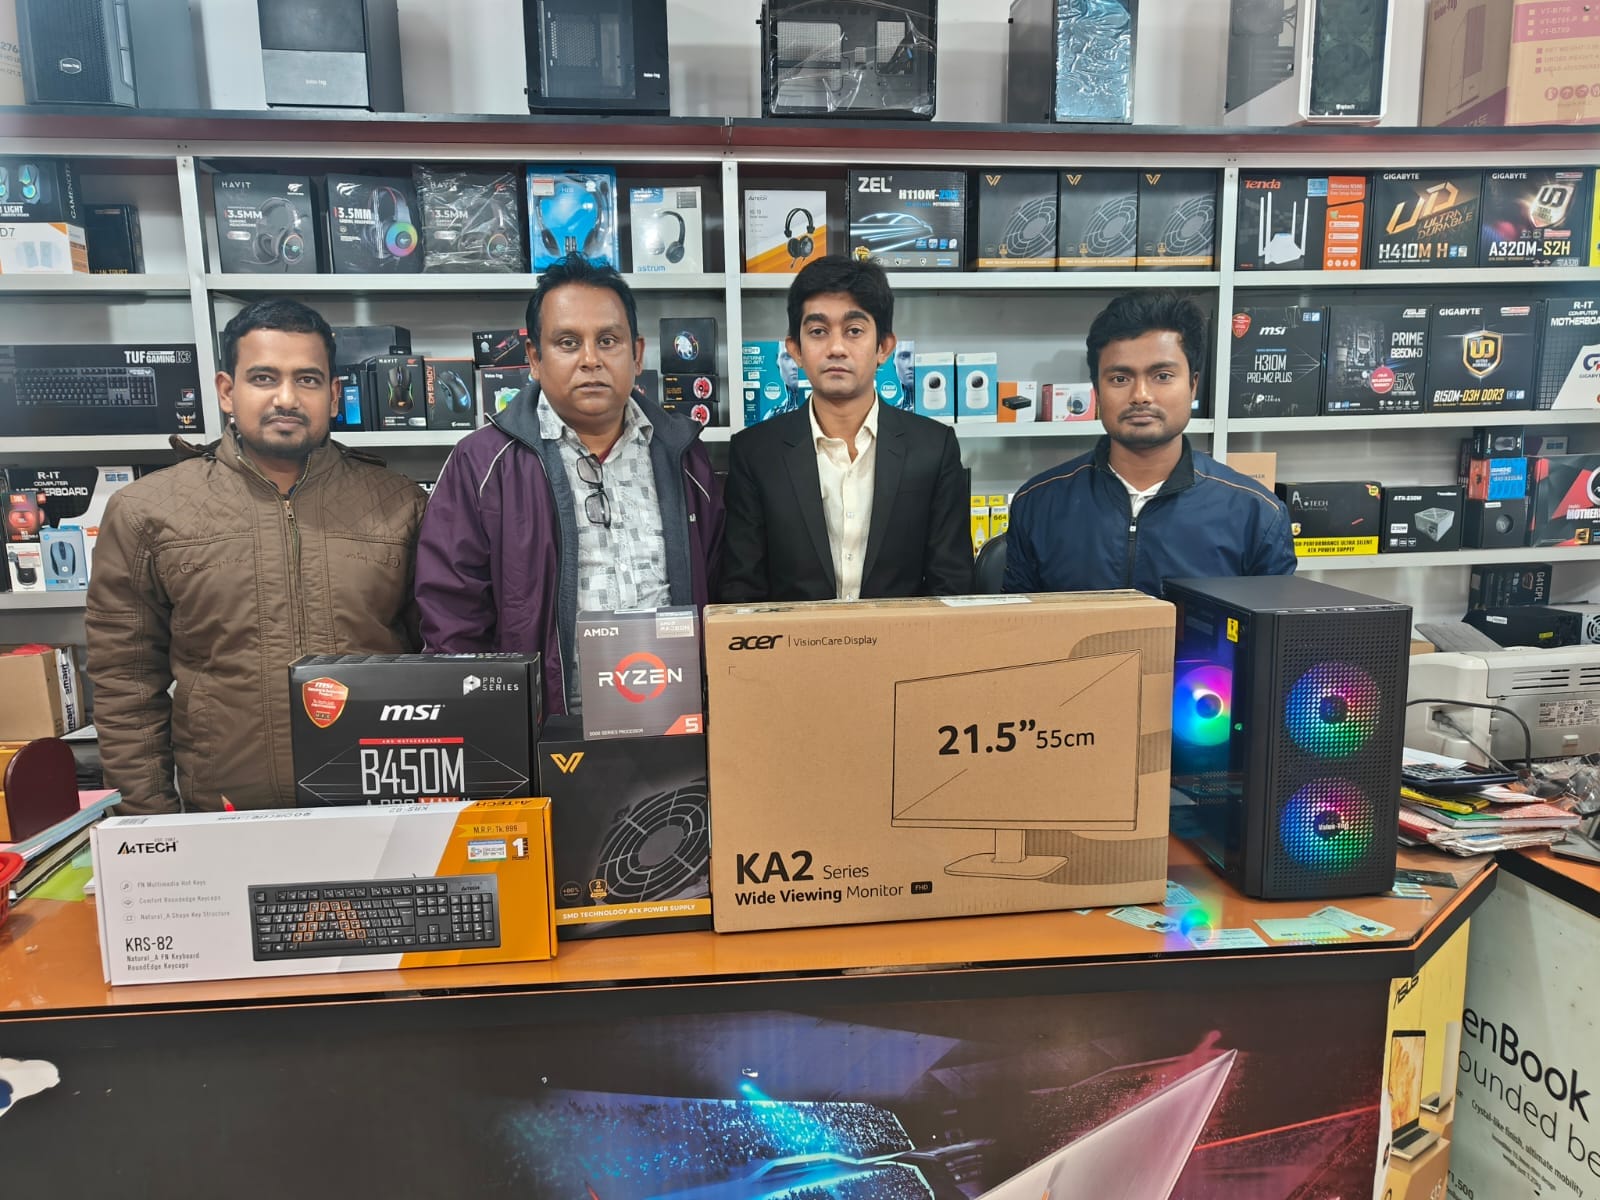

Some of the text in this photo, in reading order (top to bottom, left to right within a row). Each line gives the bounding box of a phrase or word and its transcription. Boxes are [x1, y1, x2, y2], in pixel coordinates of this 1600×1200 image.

[1492, 172, 1527, 180] GIGABYTE
[221, 181, 252, 189] HAVIT
[858, 176, 892, 193] ZEL
[1245, 179, 1282, 189] Tenda
[227, 209, 263, 219] 3.5MM
[338, 207, 372, 219] 3.5MM
[435, 209, 468, 219] 3.5MM
[1379, 243, 1448, 259] H410M H
[1489, 241, 1570, 257] A320M-S2H
[637, 264, 666, 272] astrum
[1439, 307, 1481, 316] GIGABYTE
[1573, 301, 1594, 309] R-IT
[1259, 325, 1288, 336] msi
[1391, 331, 1425, 346] PRIME
[124, 351, 146, 364] TUF
[146, 354, 175, 364] GAMING
[1390, 348, 1423, 359] B250M-D
[1254, 354, 1287, 371] H310M
[1247, 371, 1293, 383] PRO-M2 PLUS
[1433, 388, 1505, 403] B150M-D3H DDR3
[37, 471, 60, 480] R-IT
[584, 627, 610, 637] AMD
[728, 634, 784, 651] acer
[793, 635, 878, 648] VisionCare Display
[598, 667, 683, 687] RYZEN
[380, 704, 442, 721] msi
[685, 717, 699, 733] 5
[1036, 730, 1095, 749] 55cm
[360, 747, 465, 795] B450M
[512, 837, 524, 857] 1
[736, 850, 814, 885] KA2
[823, 864, 869, 880] Series
[146, 880, 179, 888] Multimedia
[735, 891, 776, 906] Wide
[780, 888, 842, 904] Viewing
[846, 884, 904, 899] Monitor
[171, 912, 190, 920] Shape
[580, 909, 627, 918] TECHNOLOGY
[643, 905, 668, 913] POWER
[670, 904, 695, 912] SUPPLY
[125, 935, 174, 953] KRS-82
[171, 952, 200, 961] Keyboard
[127, 962, 189, 971] RoundEdge Keycaps
[1462, 1007, 1591, 1123] enBook
[1459, 1050, 1558, 1142] ounded
[1471, 1099, 1505, 1132] Crystal-like
[1525, 1144, 1554, 1173] ultimate
[1554, 1164, 1584, 1198] mobility
